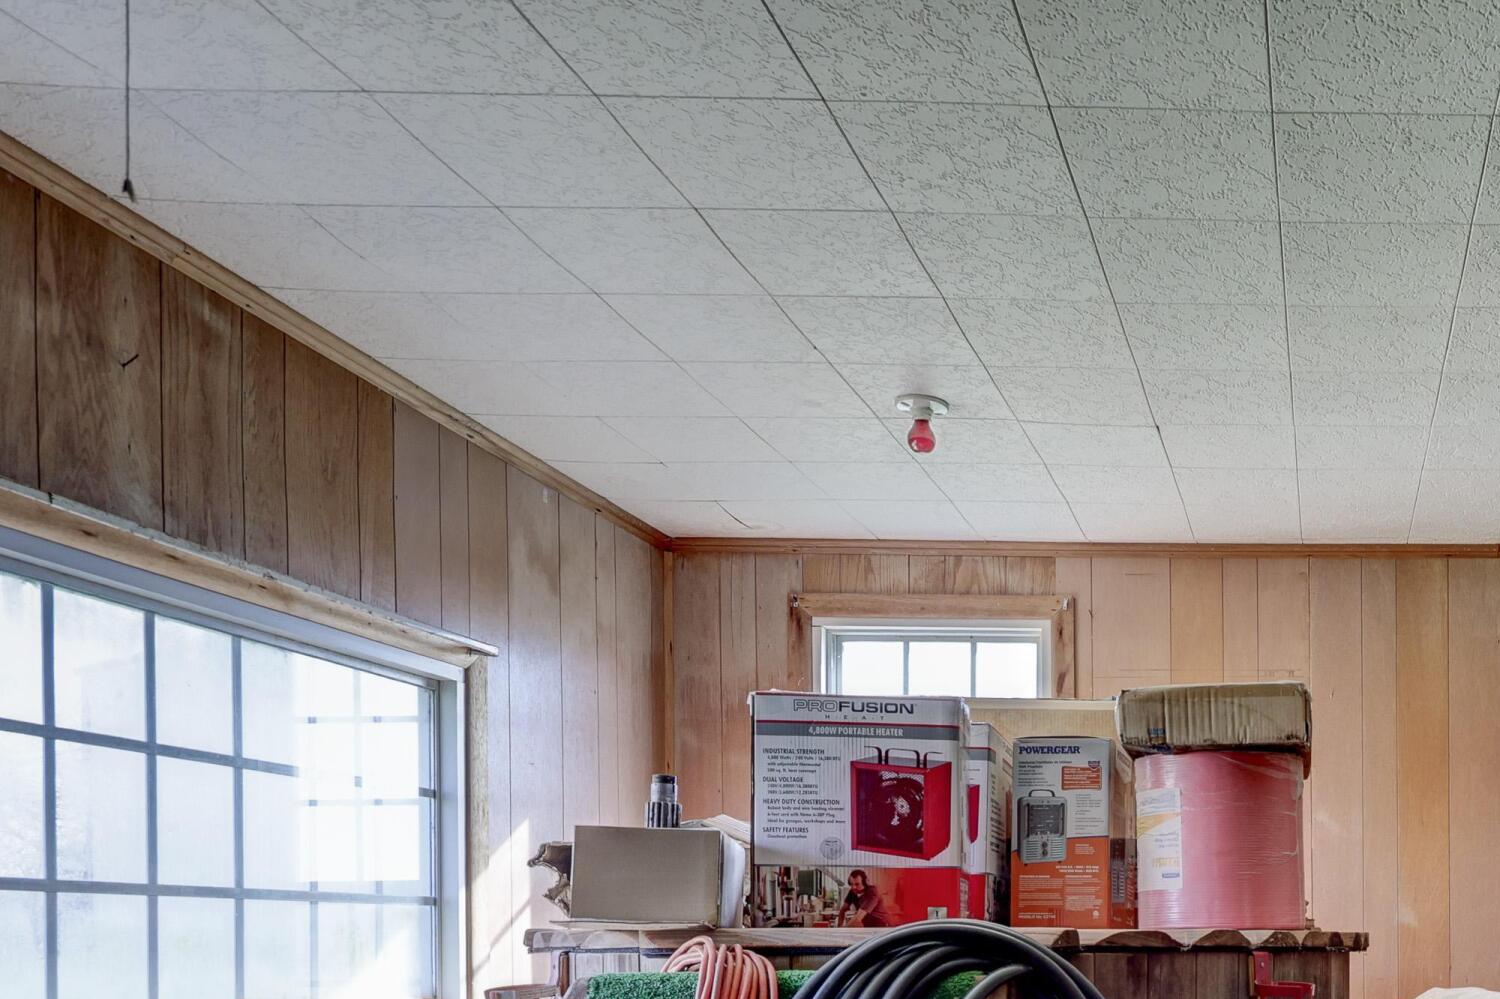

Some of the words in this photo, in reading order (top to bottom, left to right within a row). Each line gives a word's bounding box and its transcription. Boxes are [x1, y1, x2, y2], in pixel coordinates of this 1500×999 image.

[793, 699, 914, 714] PROFUSION
[808, 727, 837, 736] 4,800W
[838, 727, 874, 736] PORTABLE
[875, 728, 904, 737] HEATER
[1018, 745, 1081, 755] POWERGEAR
